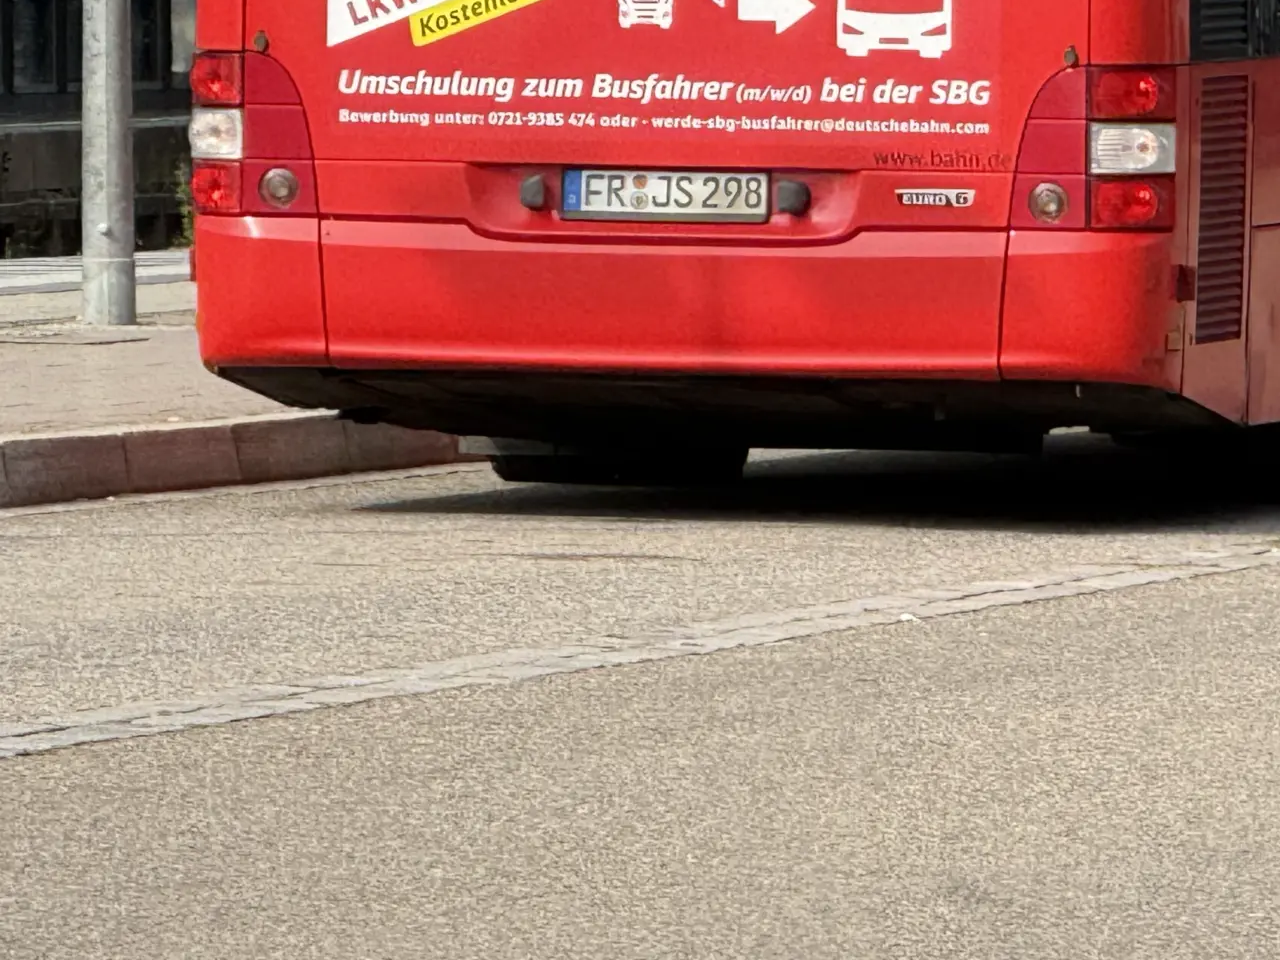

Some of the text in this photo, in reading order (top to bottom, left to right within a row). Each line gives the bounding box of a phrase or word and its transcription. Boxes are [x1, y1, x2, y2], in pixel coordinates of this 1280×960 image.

[337, 69, 991, 106] Umschulung zum Busfahrer (m/w/d) bei der SBG
[338, 108, 431, 127] Bewerbung
[434, 111, 485, 126] unter:
[568, 112, 595, 127] 474
[600, 113, 639, 128] oder
[873, 149, 1014, 172] www.bahn.de
[585, 174, 763, 210] FR JS 298
